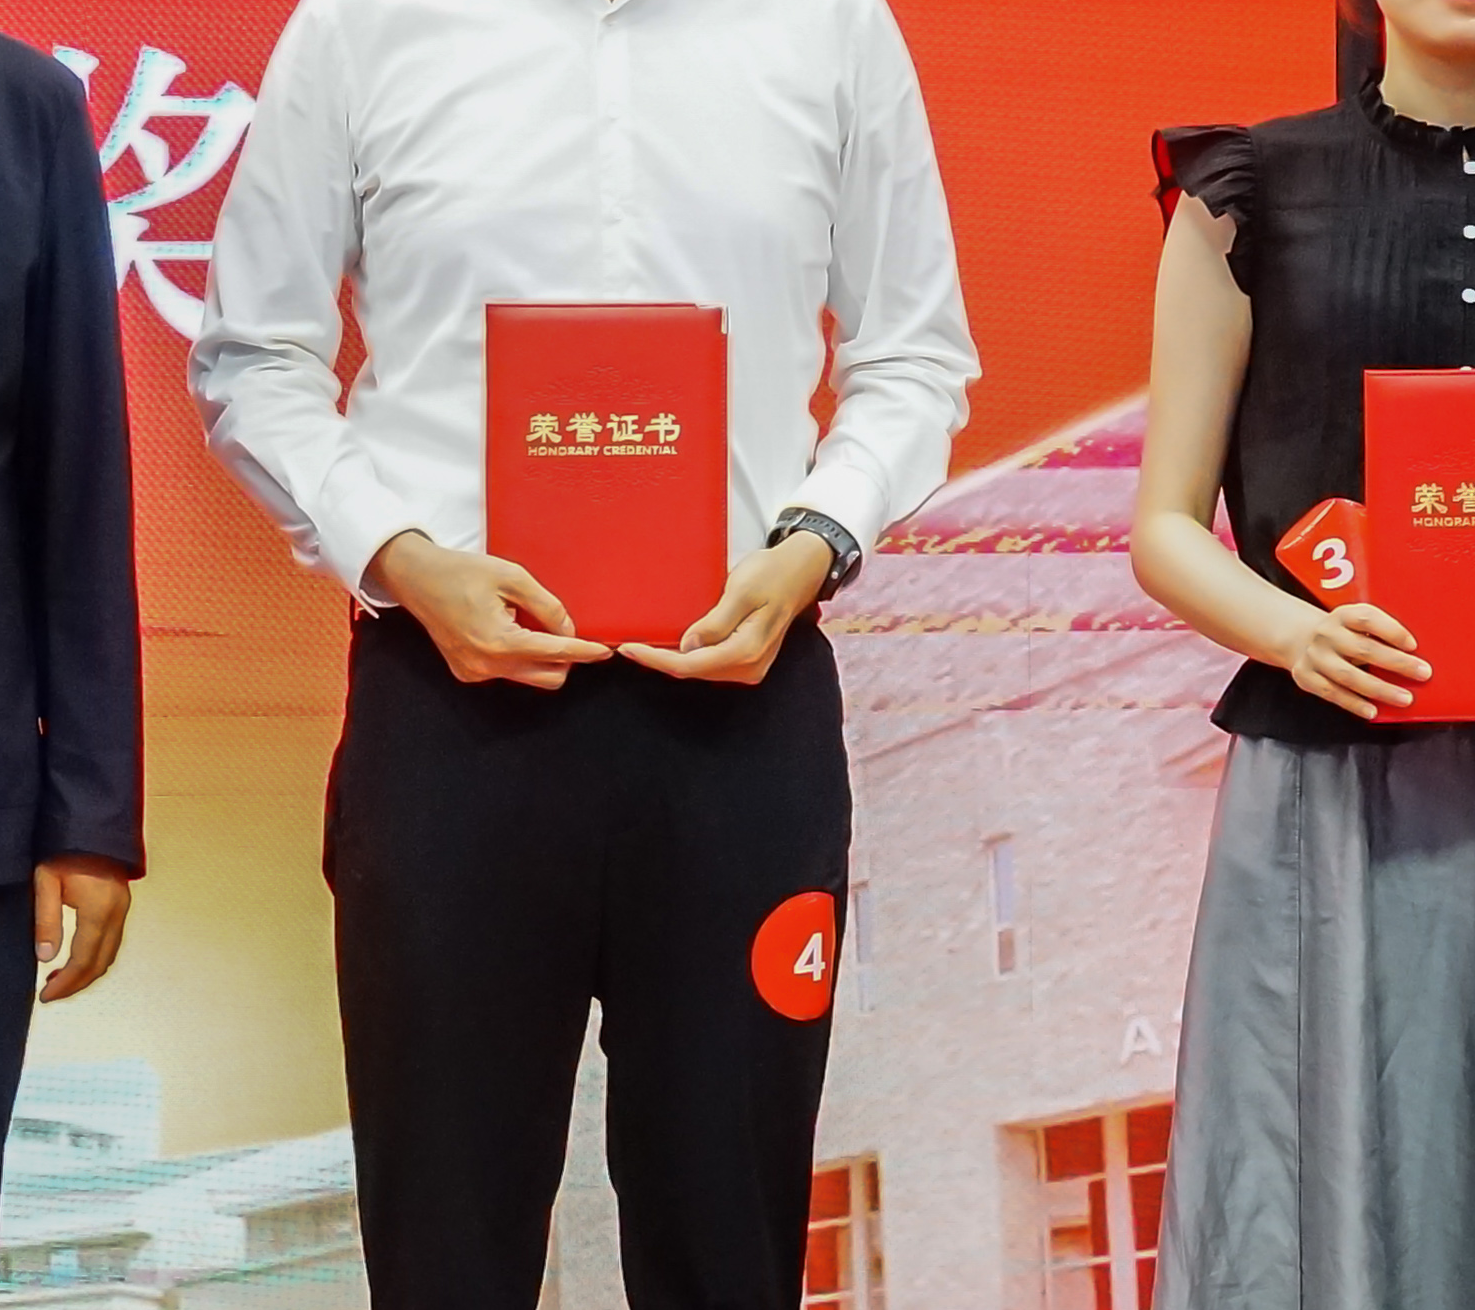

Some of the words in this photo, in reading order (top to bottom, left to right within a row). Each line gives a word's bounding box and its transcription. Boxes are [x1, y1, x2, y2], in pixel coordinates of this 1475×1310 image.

[525, 412, 682, 444] 荣誉证书
[528, 446, 600, 456] HONORARY
[603, 445, 678, 456] CREDENTIAL
[1312, 538, 1355, 590] 3
[793, 932, 826, 982] 4
